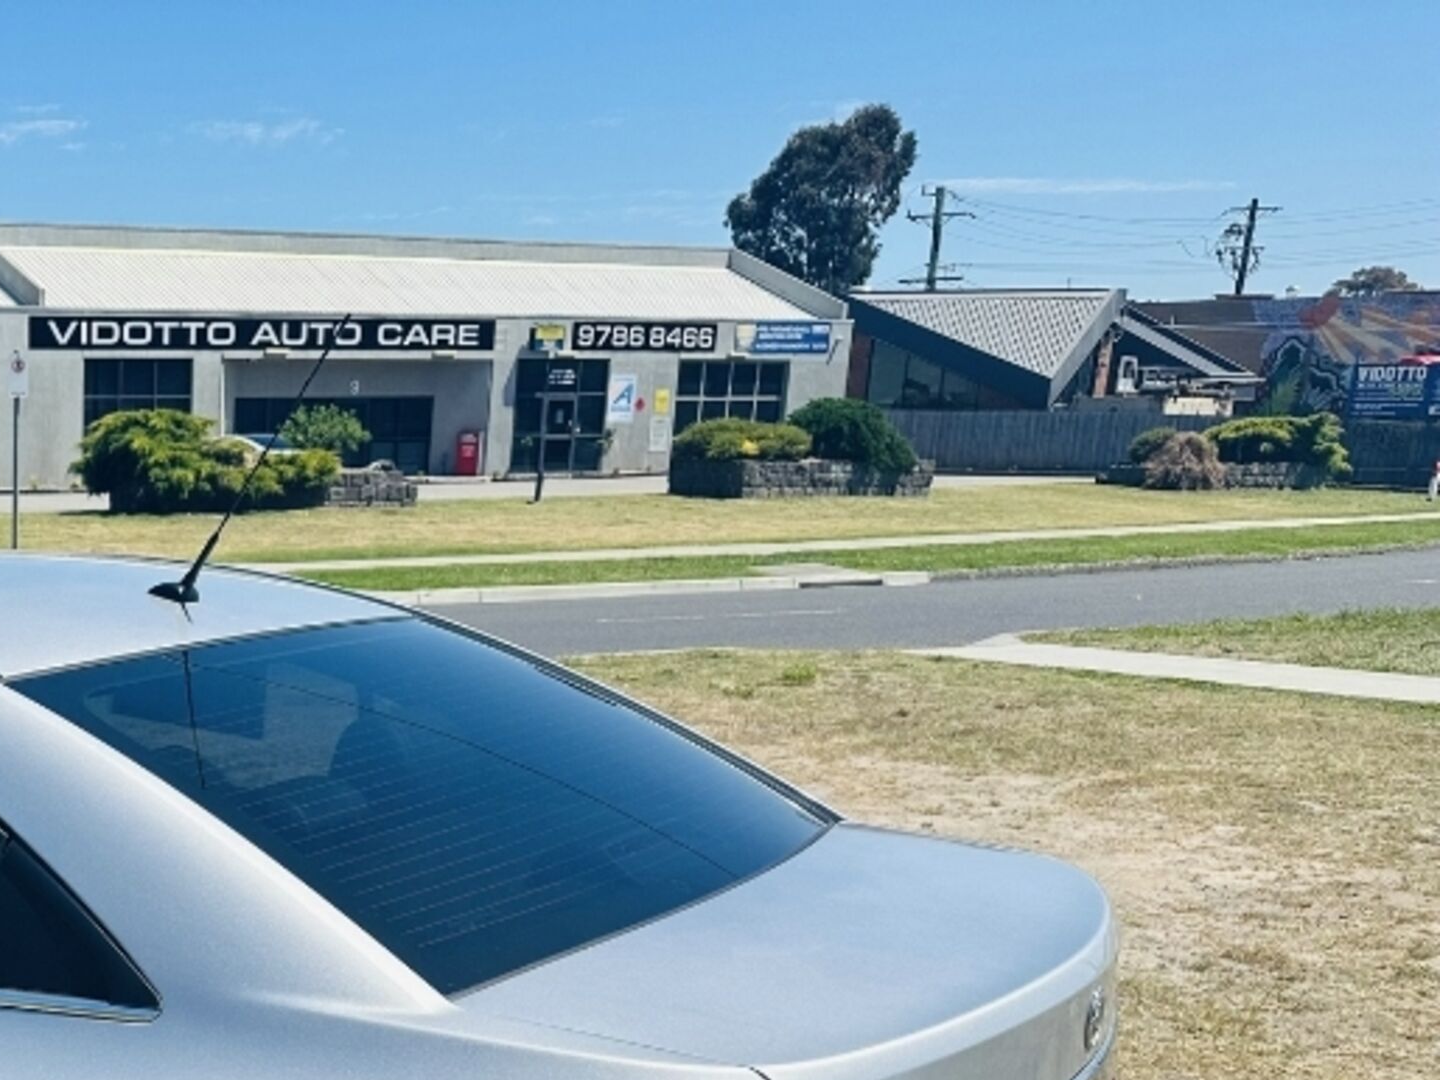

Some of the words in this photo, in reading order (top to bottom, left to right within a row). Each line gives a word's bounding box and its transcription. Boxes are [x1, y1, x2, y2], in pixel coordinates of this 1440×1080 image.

[47, 320, 236, 346] VIDOTTO
[250, 321, 363, 346] AUTO
[377, 323, 480, 346] CARE
[577, 324, 646, 347] 9786
[648, 326, 714, 348] 8466
